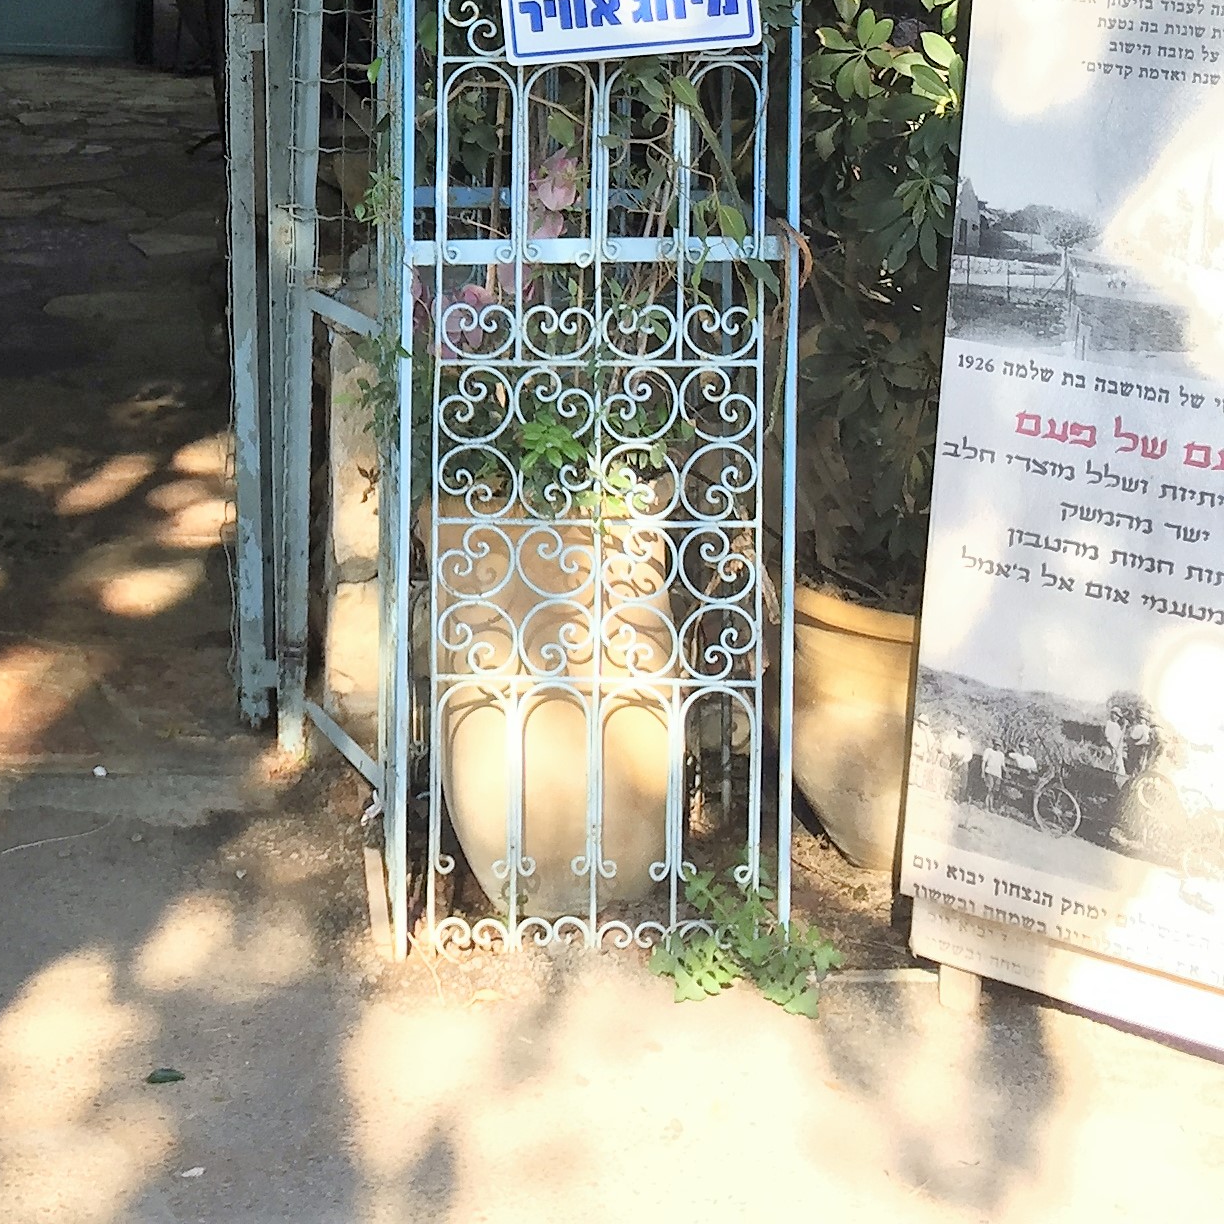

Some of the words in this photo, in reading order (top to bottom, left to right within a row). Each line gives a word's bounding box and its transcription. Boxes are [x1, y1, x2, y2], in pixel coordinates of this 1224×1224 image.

[1097, 16, 1134, 32] נטעת
[1139, 20, 1159, 33] בה
[1164, 23, 1206, 38] שונות
[1109, 40, 1152, 56] הישוב
[1157, 45, 1195, 61] מזבח
[1201, 44, 1220, 63] על
[1138, 66, 1186, 81] ואדמת
[958, 353, 995, 373] 1926
[1002, 359, 1054, 383] שלמה
[1061, 371, 1086, 389] בת
[1094, 376, 1170, 404] המושבה
[1179, 385, 1205, 409] של
[1015, 410, 1097, 449] פעם
[1113, 415, 1168, 460] של
[942, 436, 996, 465] חלב
[1005, 452, 1076, 482] מוצרי
[1085, 459, 1149, 495] ושלל
[1060, 501, 1153, 535] מהמשק
[1007, 527, 1099, 561] מהטבון
[1164, 521, 1210, 544] ישר
[962, 545, 1030, 584] ג'אמל
[1109, 549, 1175, 576] חמות
[1041, 563, 1075, 593] אל
[1085, 580, 1130, 605] אום
[913, 854, 939, 871] יום
[946, 864, 984, 886] יבוא
[913, 883, 976, 913] ובששון
[993, 877, 1053, 908] הנצחון
[983, 904, 1047, 934] בשמחה
[1061, 897, 1107, 920] ימתק
